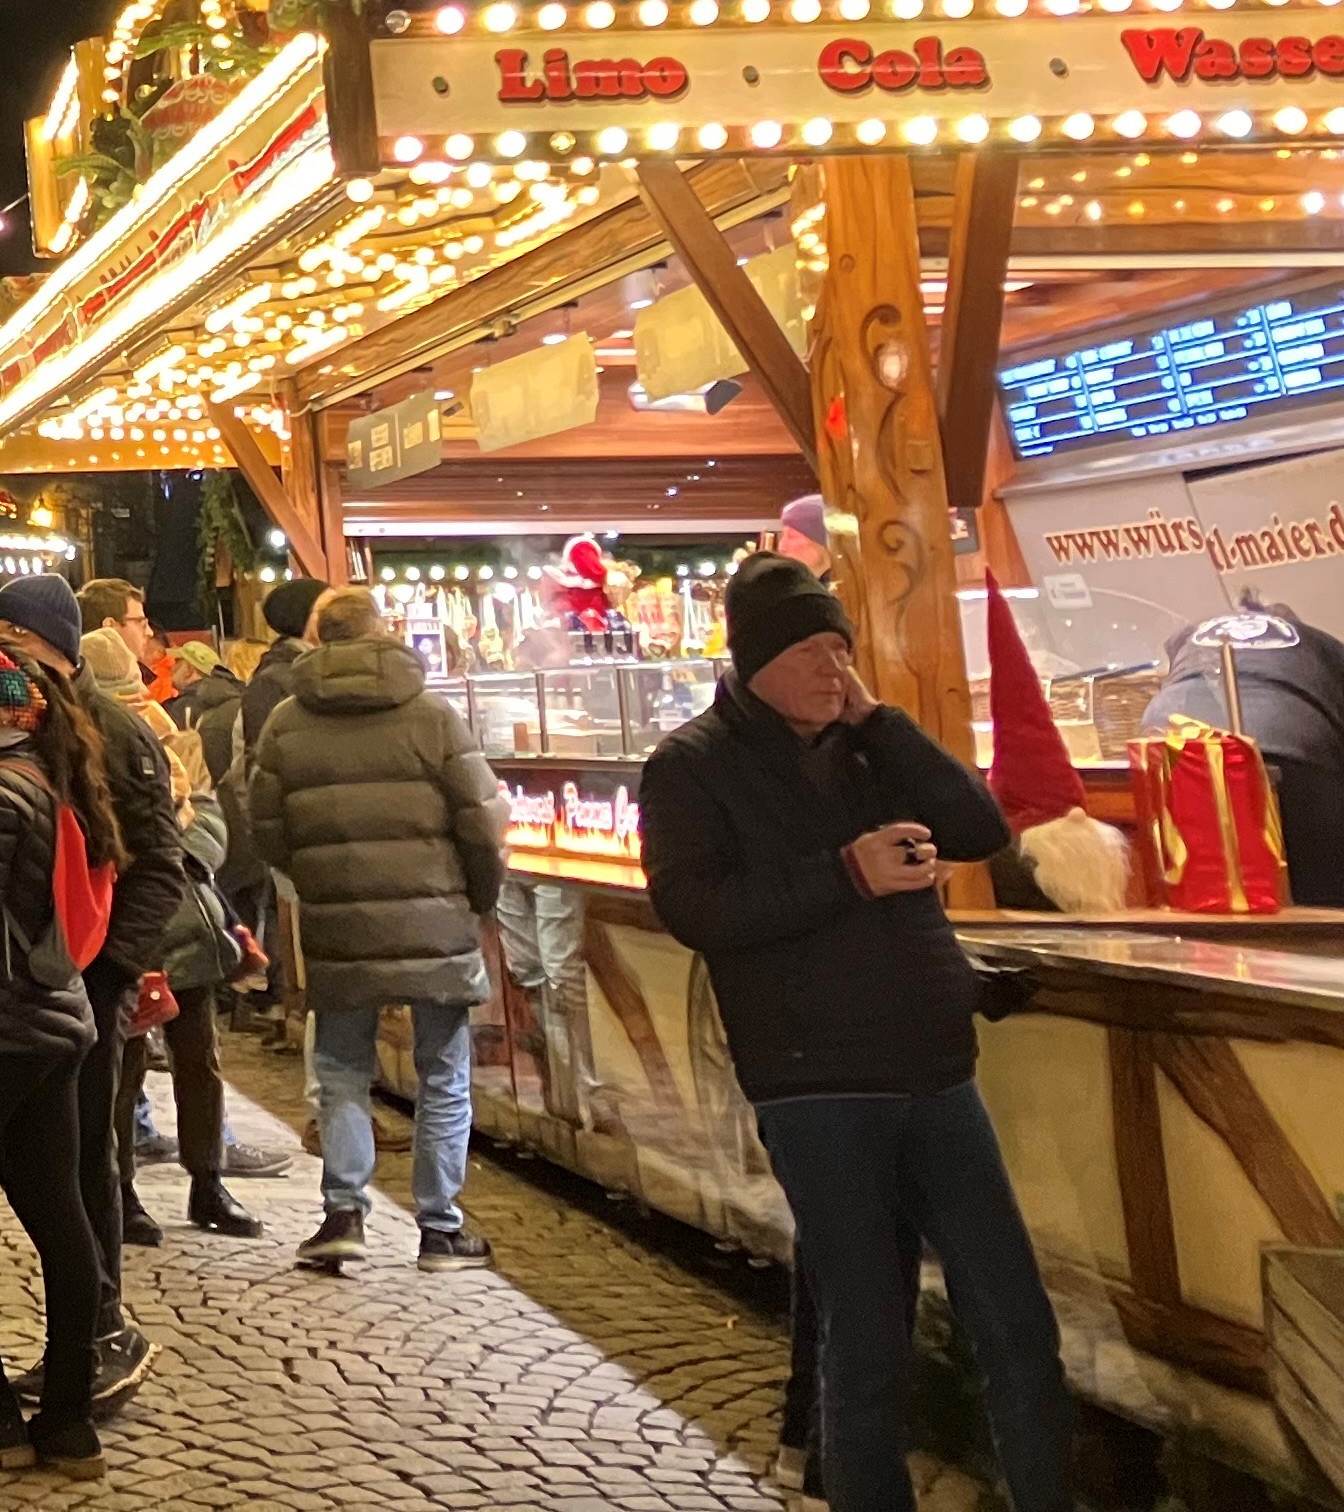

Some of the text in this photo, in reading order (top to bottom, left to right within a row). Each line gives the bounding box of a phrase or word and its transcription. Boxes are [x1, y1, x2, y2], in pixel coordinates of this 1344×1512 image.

[496, 29, 1344, 102] Limo Cola Wasse
